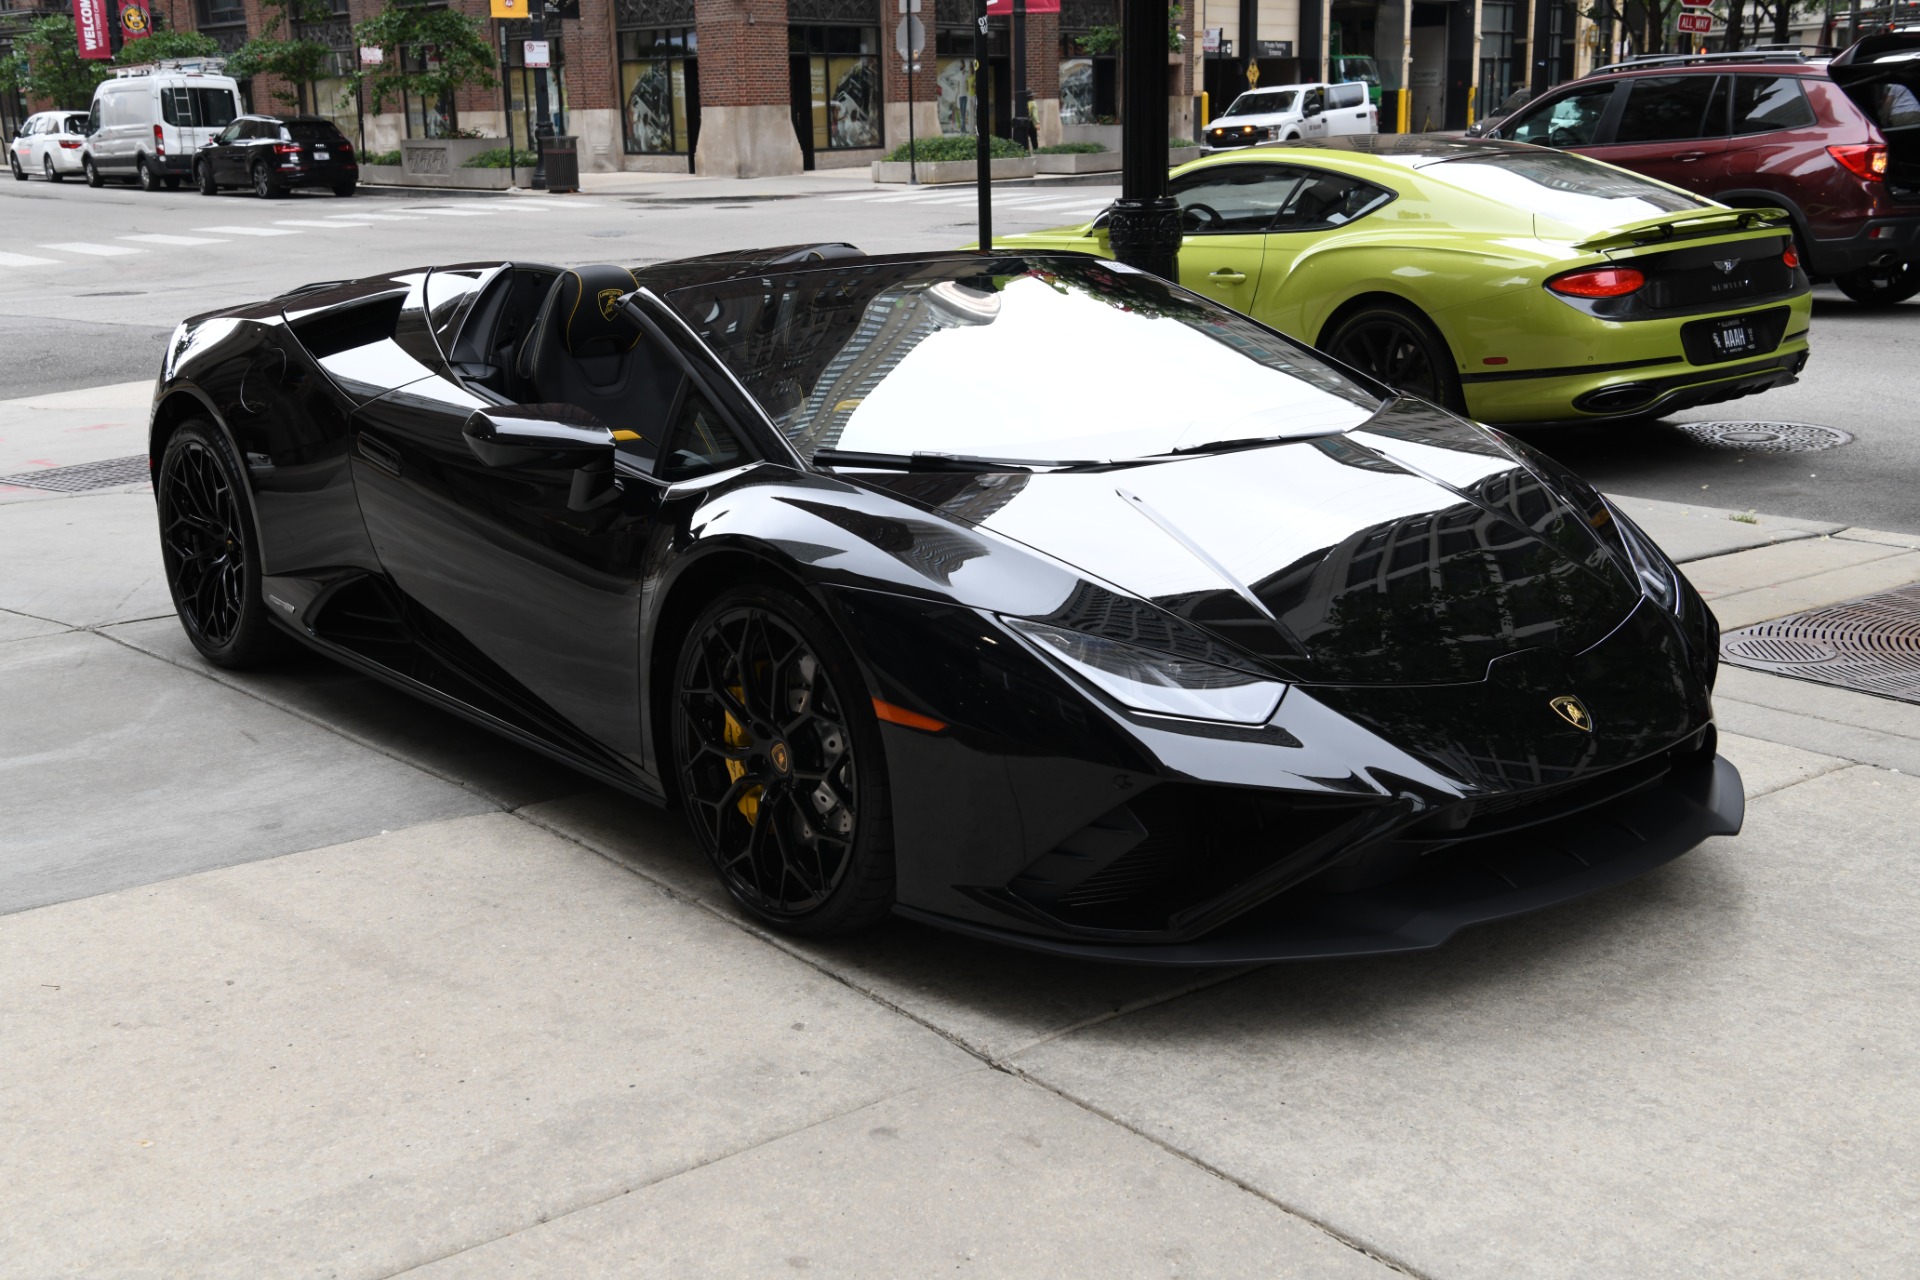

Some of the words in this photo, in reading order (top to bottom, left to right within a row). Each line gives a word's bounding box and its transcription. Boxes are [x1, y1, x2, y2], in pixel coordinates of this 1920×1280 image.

[1681, 17, 1693, 28] ALL
[1695, 18, 1709, 30] WAY
[1723, 327, 1746, 348] AAAH
